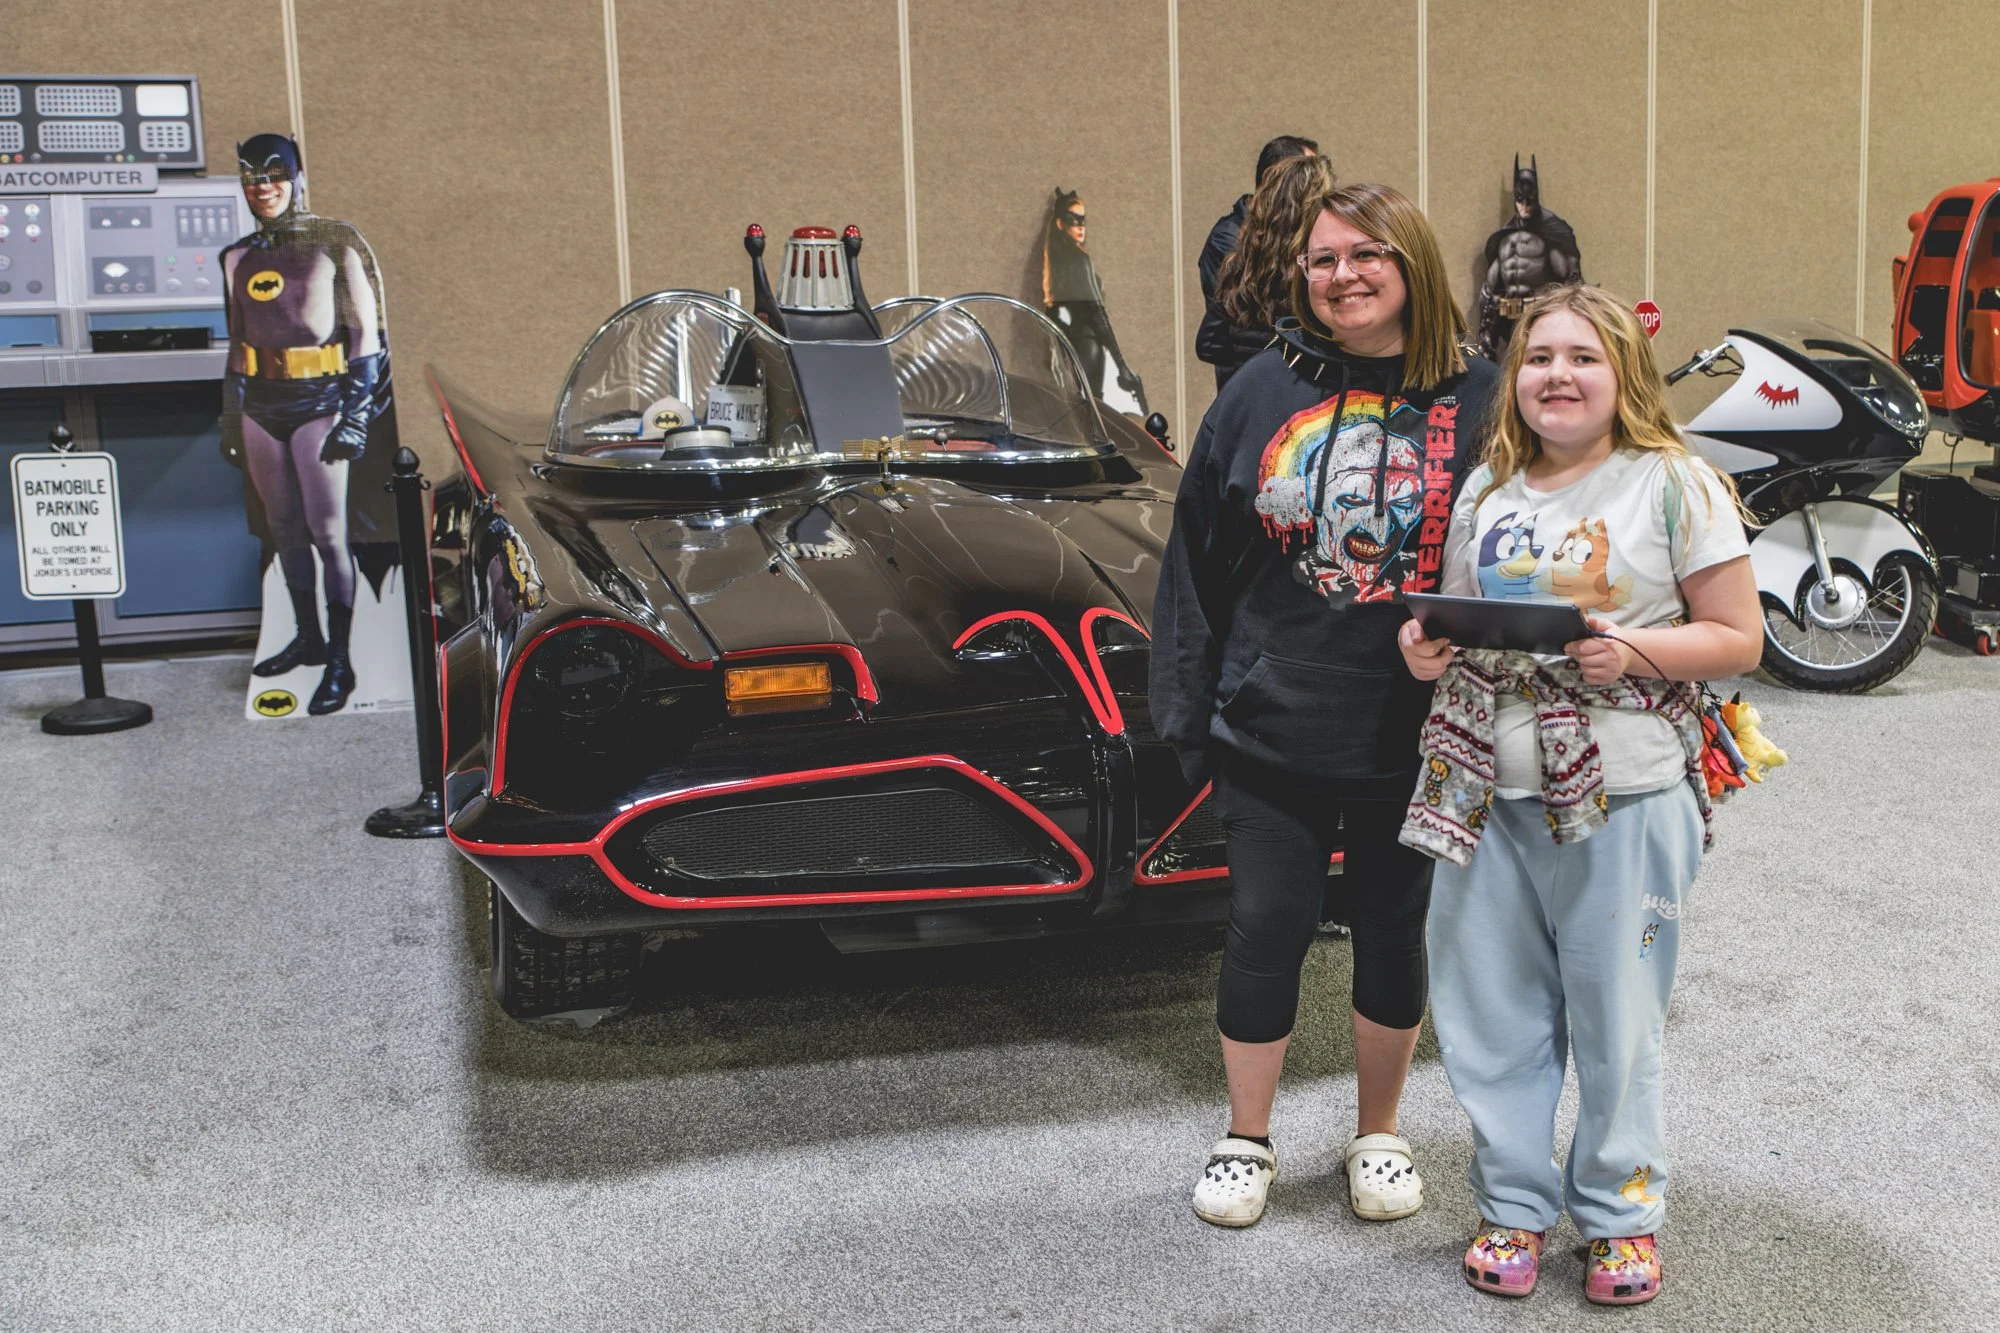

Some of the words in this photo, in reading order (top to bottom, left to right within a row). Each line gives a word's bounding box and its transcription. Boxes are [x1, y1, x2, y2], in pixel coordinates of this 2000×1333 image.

[0, 171, 142, 186] ATCOMPUTER
[1639, 312, 1660, 328] TOP
[710, 401, 733, 421] BRUCE
[736, 403, 760, 423] WAYNE
[24, 479, 107, 496] BATMOBILE
[1415, 404, 1461, 594] TERRIFIER
[36, 500, 100, 516] PARKING
[51, 521, 88, 537] ONLY
[32, 546, 49, 555] ALL
[51, 545, 88, 554] OTHERS
[90, 545, 111, 553] WILL
[42, 557, 54, 566] BE
[58, 556, 88, 565] TOWED
[90, 556, 102, 564] AT
[33, 568, 70, 577] JOKER'S
[73, 567, 113, 576] EXPENSE
